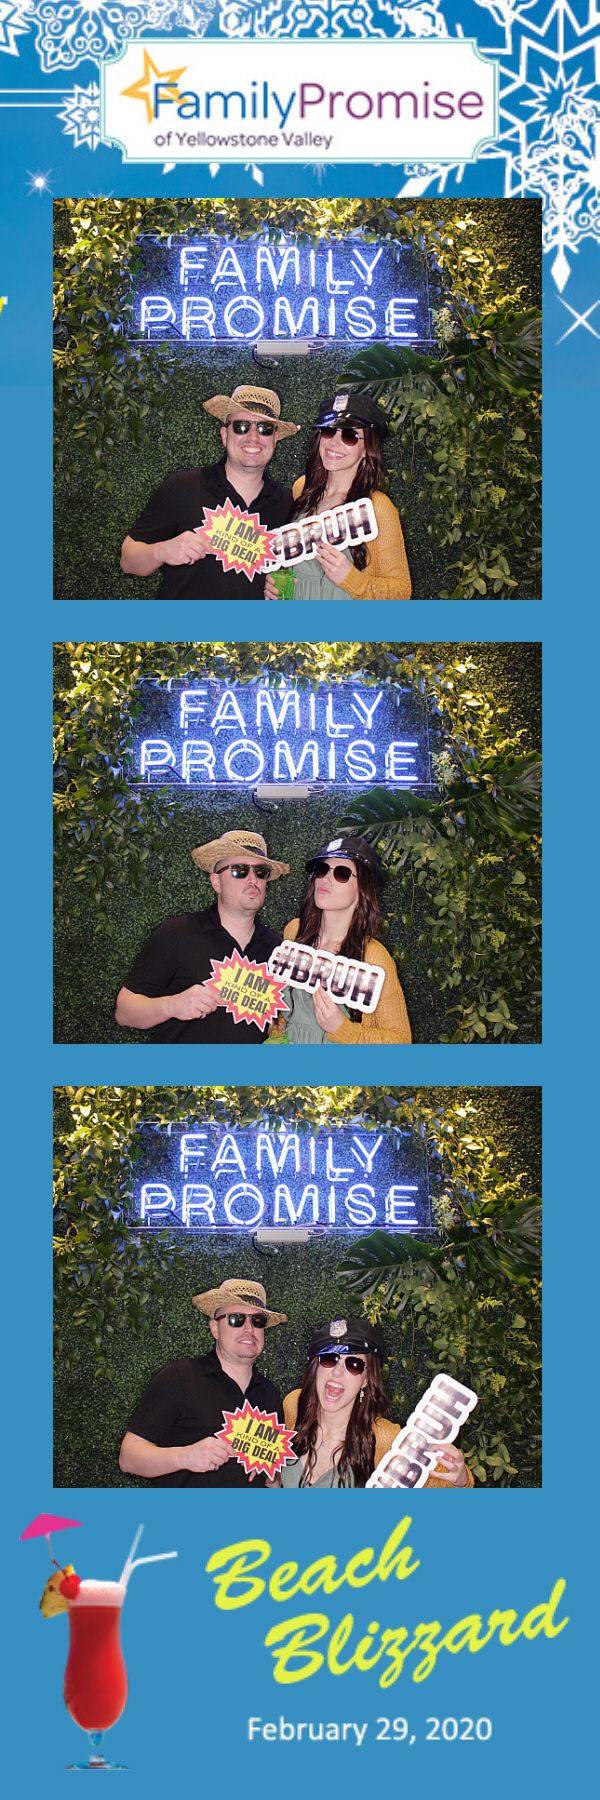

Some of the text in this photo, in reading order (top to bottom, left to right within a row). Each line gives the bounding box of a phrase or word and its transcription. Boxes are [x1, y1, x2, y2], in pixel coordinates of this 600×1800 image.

[180, 246, 383, 288] FAMILY
[140, 295, 418, 338] PROMISE
[216, 529, 239, 543] KIND
[240, 540, 254, 549] OF
[225, 517, 262, 545] I AM
[210, 534, 258, 565] BIG DEAL
[180, 690, 383, 732] FAMILY
[140, 739, 418, 782] PROMISE
[224, 981, 248, 993] KIND
[249, 990, 263, 998] OF
[234, 968, 270, 994] I AM
[272, 945, 379, 1007] #BRUH
[220, 986, 267, 1015] BIG DEAL
[180, 1134, 383, 1176] FAMILY
[140, 1183, 418, 1226] PROMISE
[236, 1432, 259, 1444] KIND
[260, 1440, 273, 1448] OF
[245, 1419, 280, 1444] I AM
[231, 1437, 277, 1464] BIG DEAL
